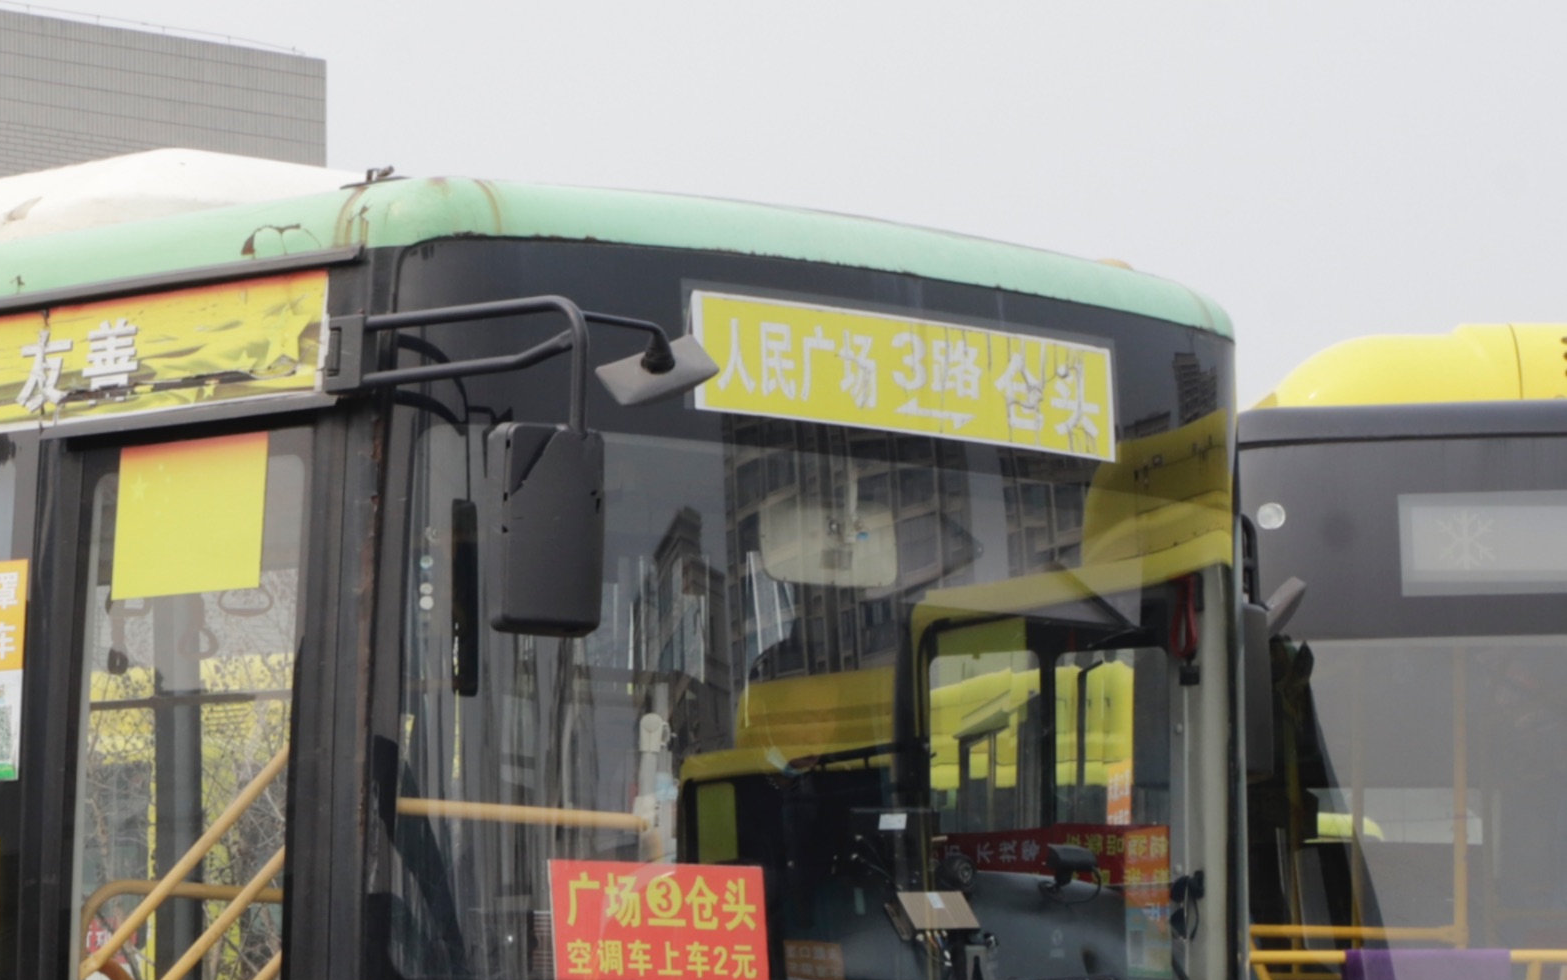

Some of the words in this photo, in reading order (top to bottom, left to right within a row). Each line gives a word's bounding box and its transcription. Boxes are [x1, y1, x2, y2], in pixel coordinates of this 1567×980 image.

[16, 318, 138, 411] 友善
[717, 318, 878, 409] 人民广场
[566, 939, 758, 979] 空调车上车2元
